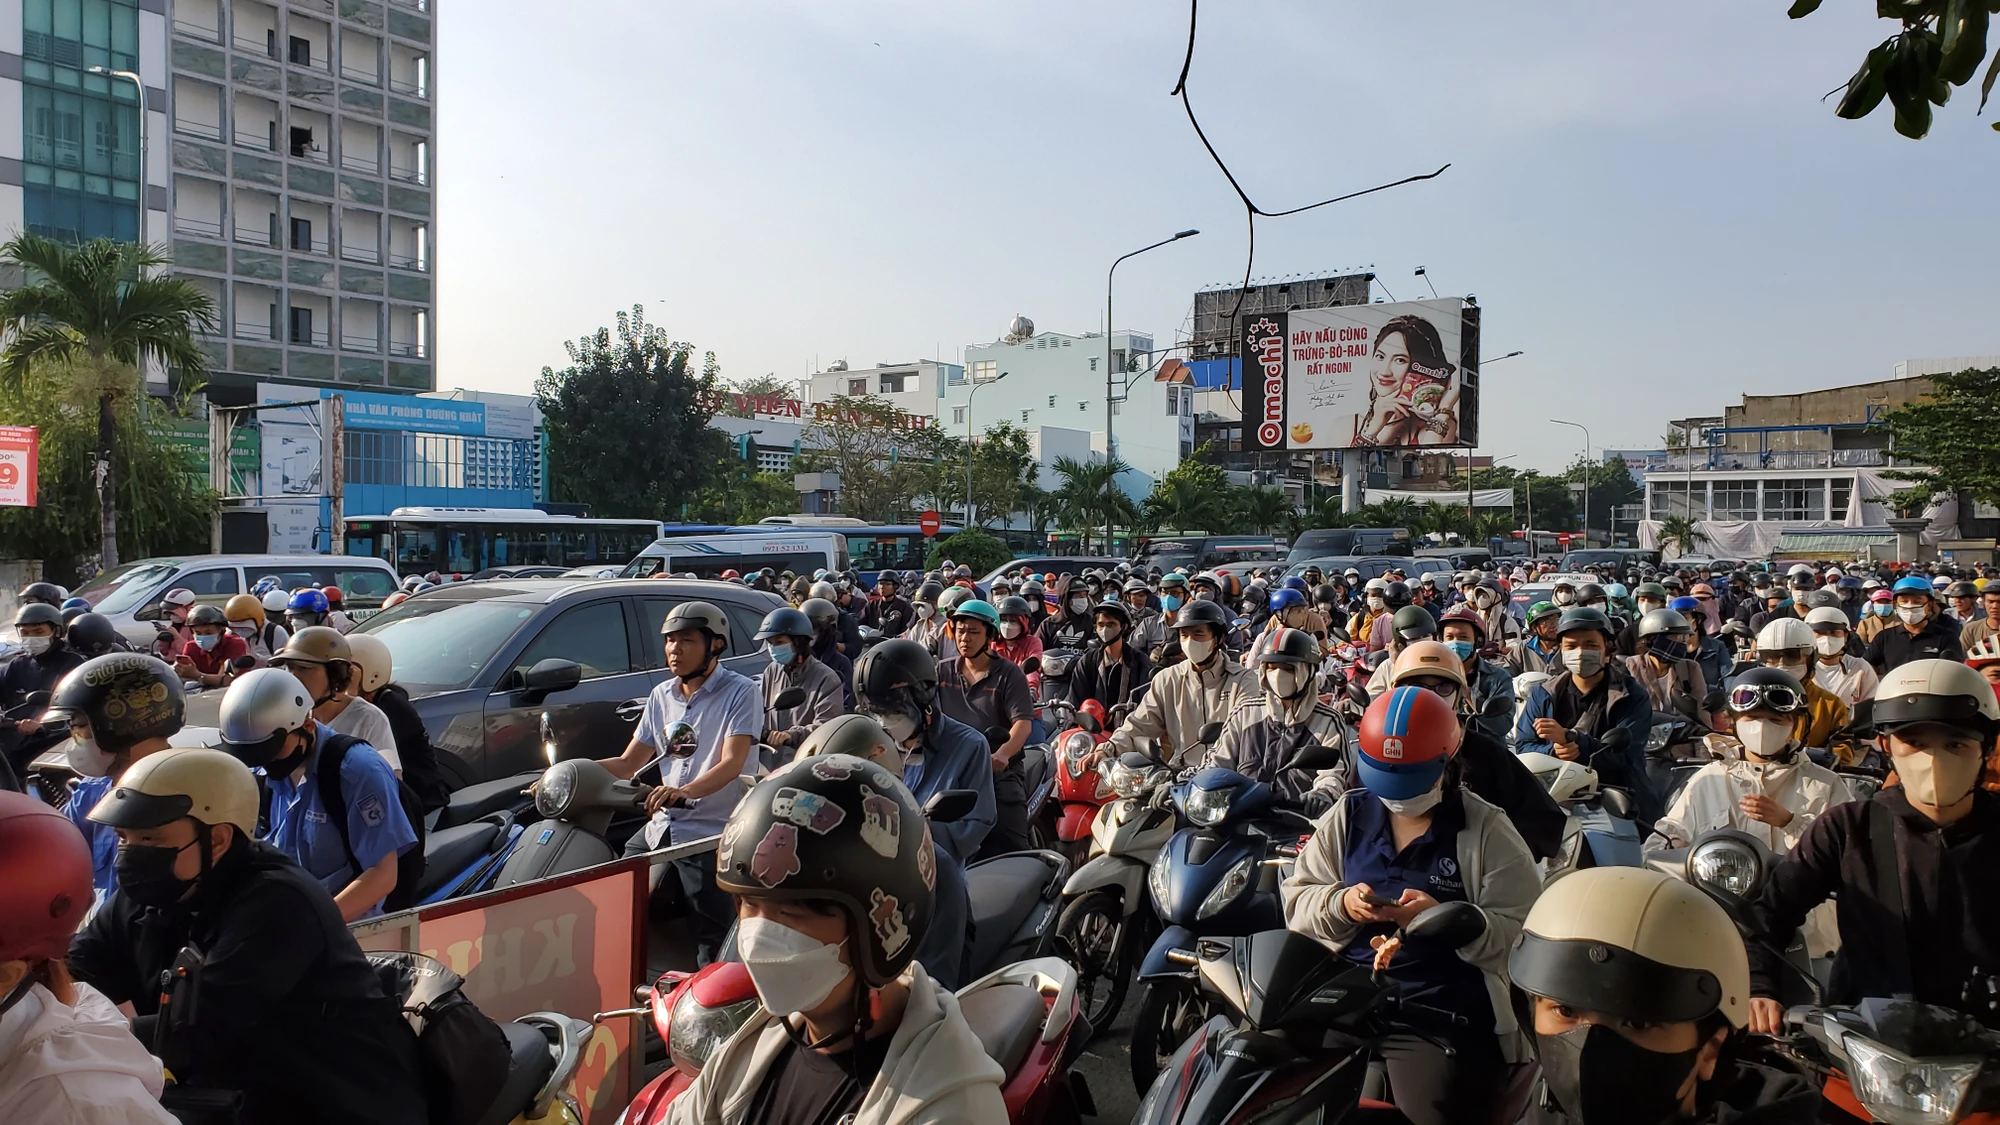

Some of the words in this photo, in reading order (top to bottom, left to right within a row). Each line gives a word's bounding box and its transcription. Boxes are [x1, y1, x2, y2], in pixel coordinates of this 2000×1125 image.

[1292, 330, 1312, 345] HÃY
[1315, 326, 1336, 343] NẤU
[1339, 326, 1368, 341] CÙNG
[1307, 361, 1323, 375] RẤT
[1325, 362, 1352, 374] NGON!
[1257, 335, 1284, 447] Omachi
[119, 657, 148, 672] Rag
[1385, 747, 1401, 757] GHN
